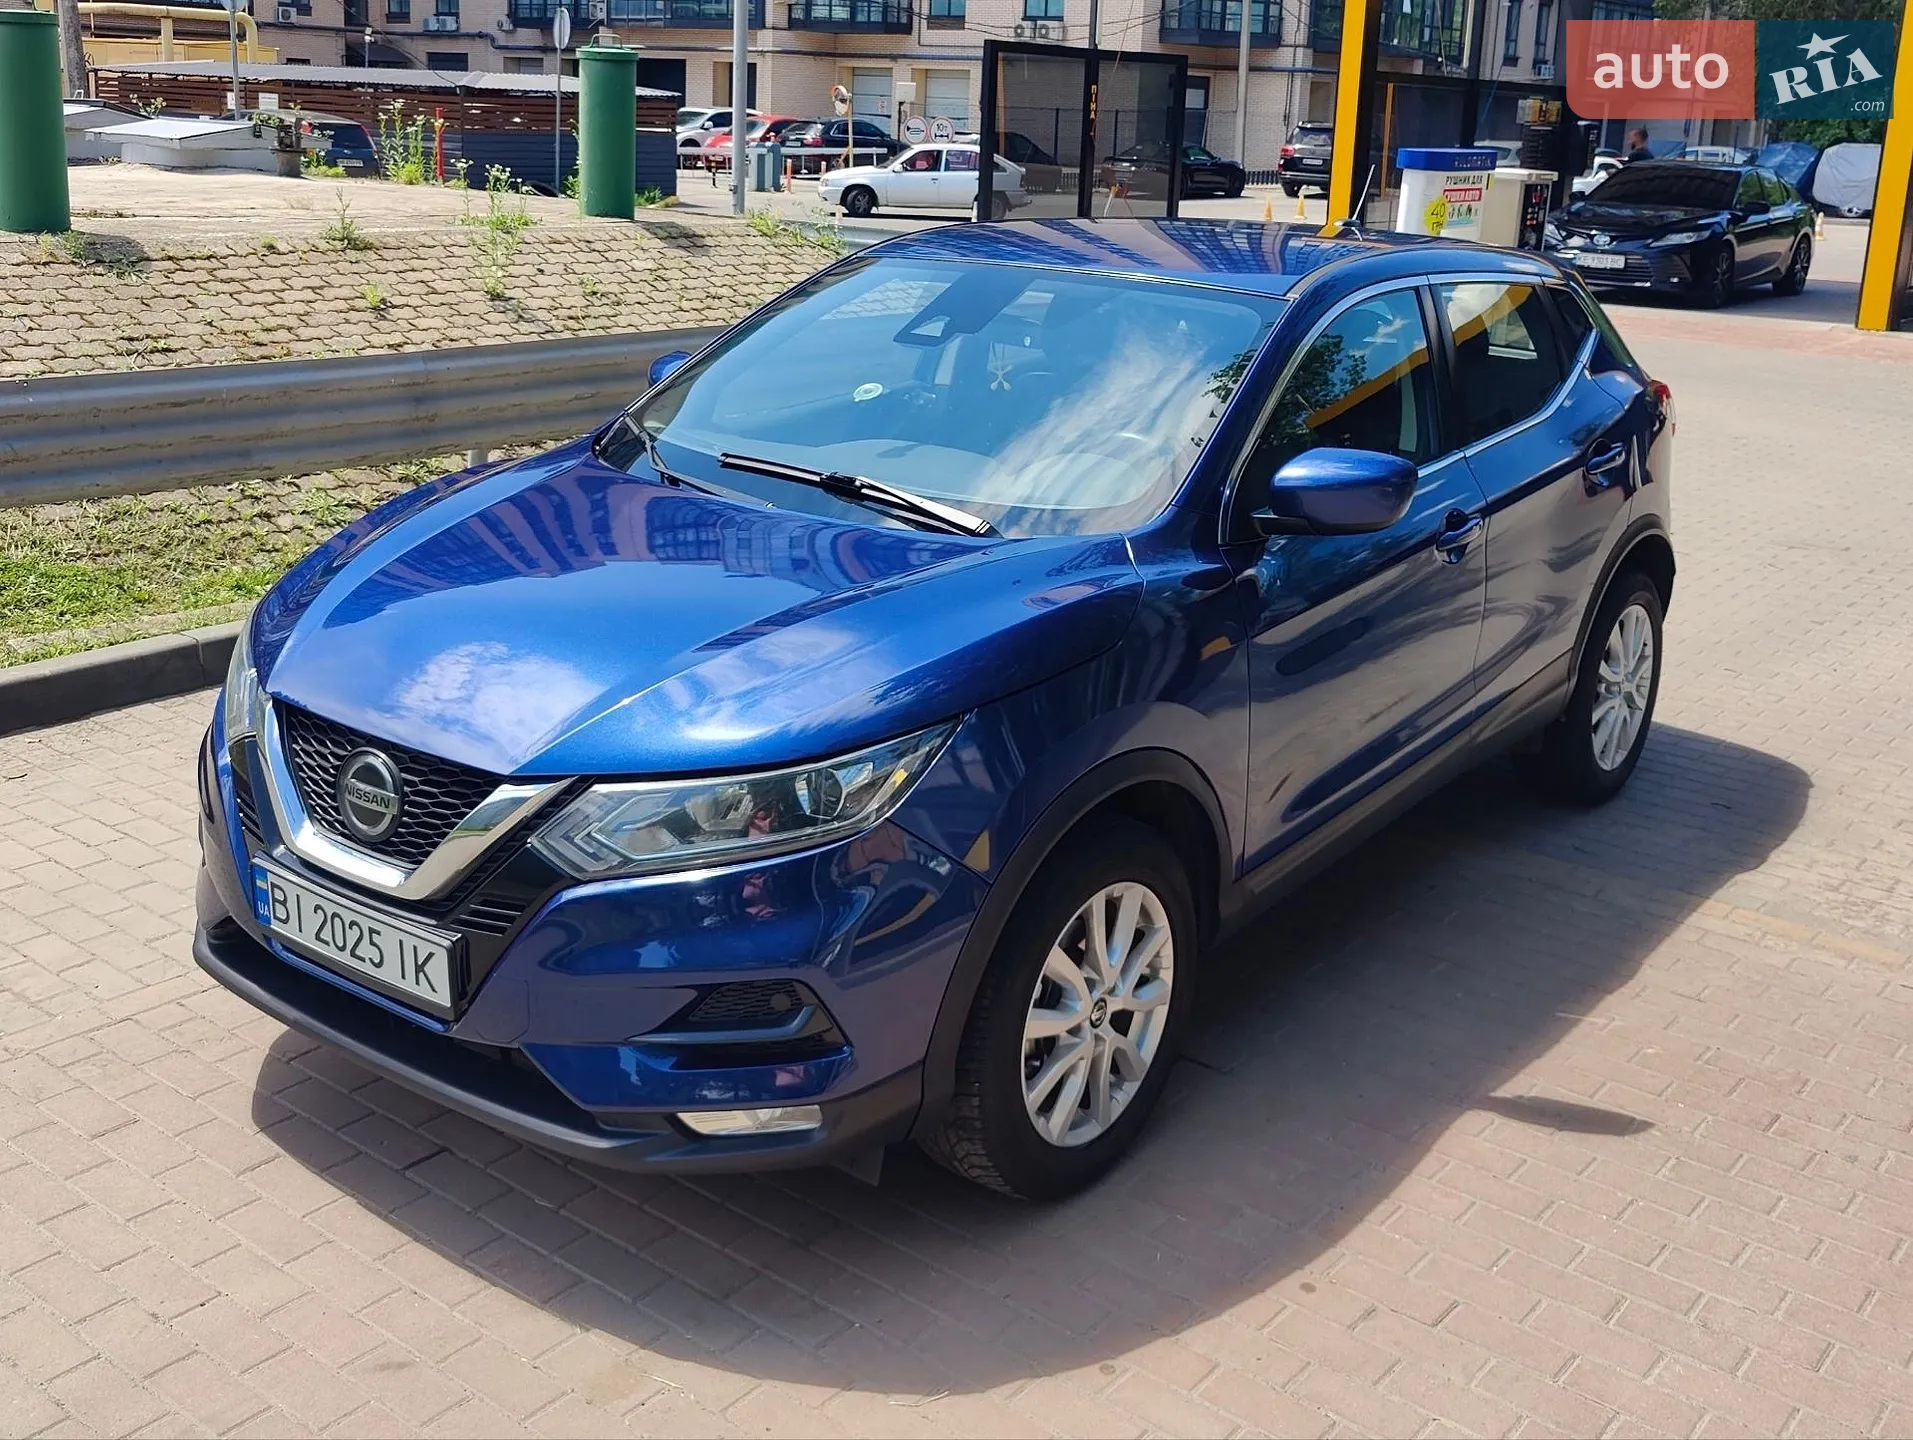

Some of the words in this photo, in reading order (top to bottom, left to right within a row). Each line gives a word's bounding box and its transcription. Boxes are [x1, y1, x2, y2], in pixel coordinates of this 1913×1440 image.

[1431, 203, 1446, 218] 40
[345, 782, 390, 809] NISSAN
[257, 900, 270, 918] UA
[270, 881, 303, 933] BI
[313, 903, 385, 969] 2025
[399, 938, 438, 993] IK
